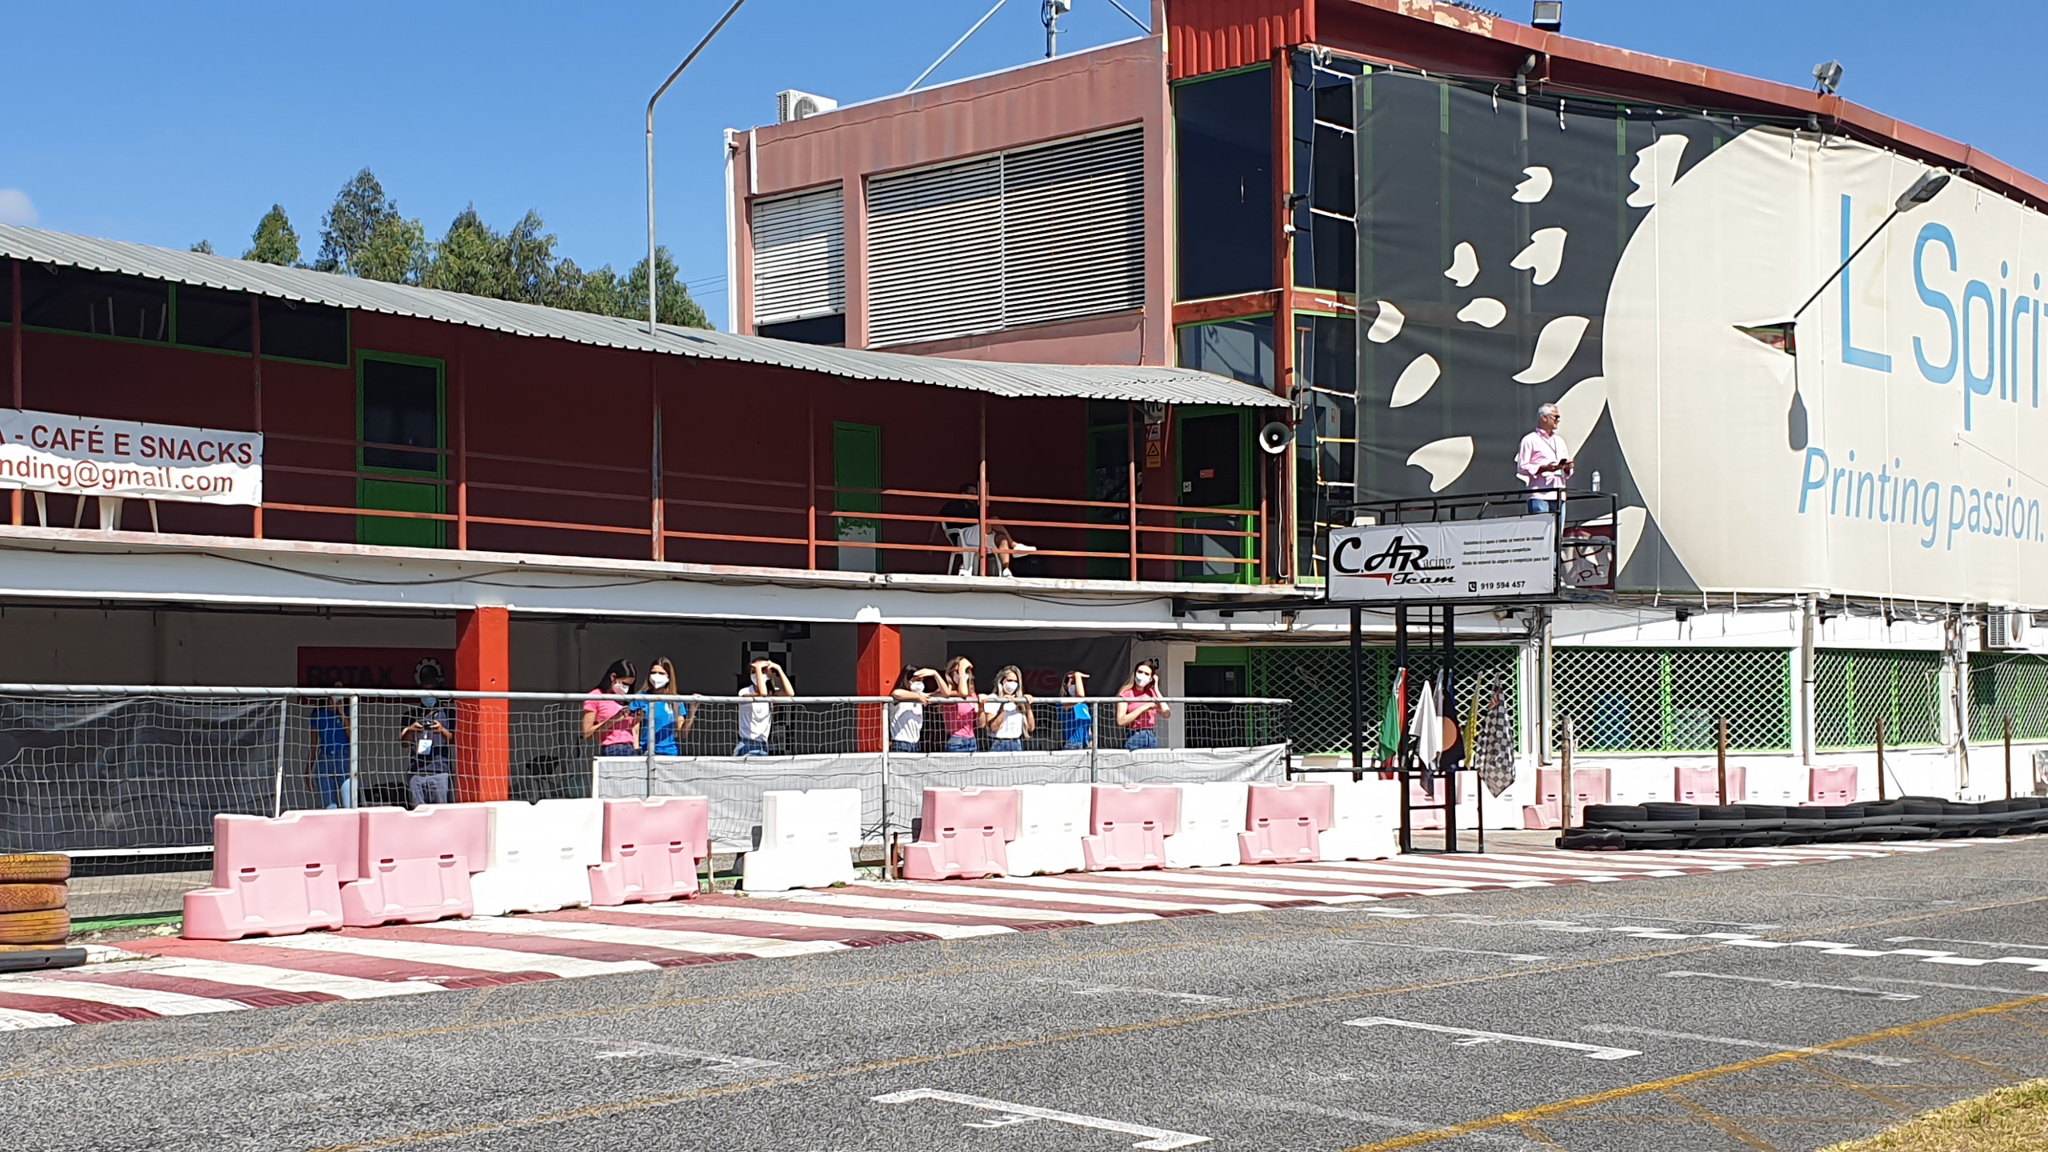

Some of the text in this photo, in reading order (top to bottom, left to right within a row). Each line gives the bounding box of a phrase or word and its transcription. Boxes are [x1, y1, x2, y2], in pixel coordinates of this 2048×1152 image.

[1912, 221, 2048, 432] Spiri
[31, 425, 104, 454] CAFÉ
[114, 433, 131, 456] E
[140, 436, 253, 465] SNACKS
[1798, 447, 2044, 551] Printing passion.
[1392, 572, 1456, 585] Team
[1481, 582, 1494, 590] 919
[1496, 581, 1510, 589] 594
